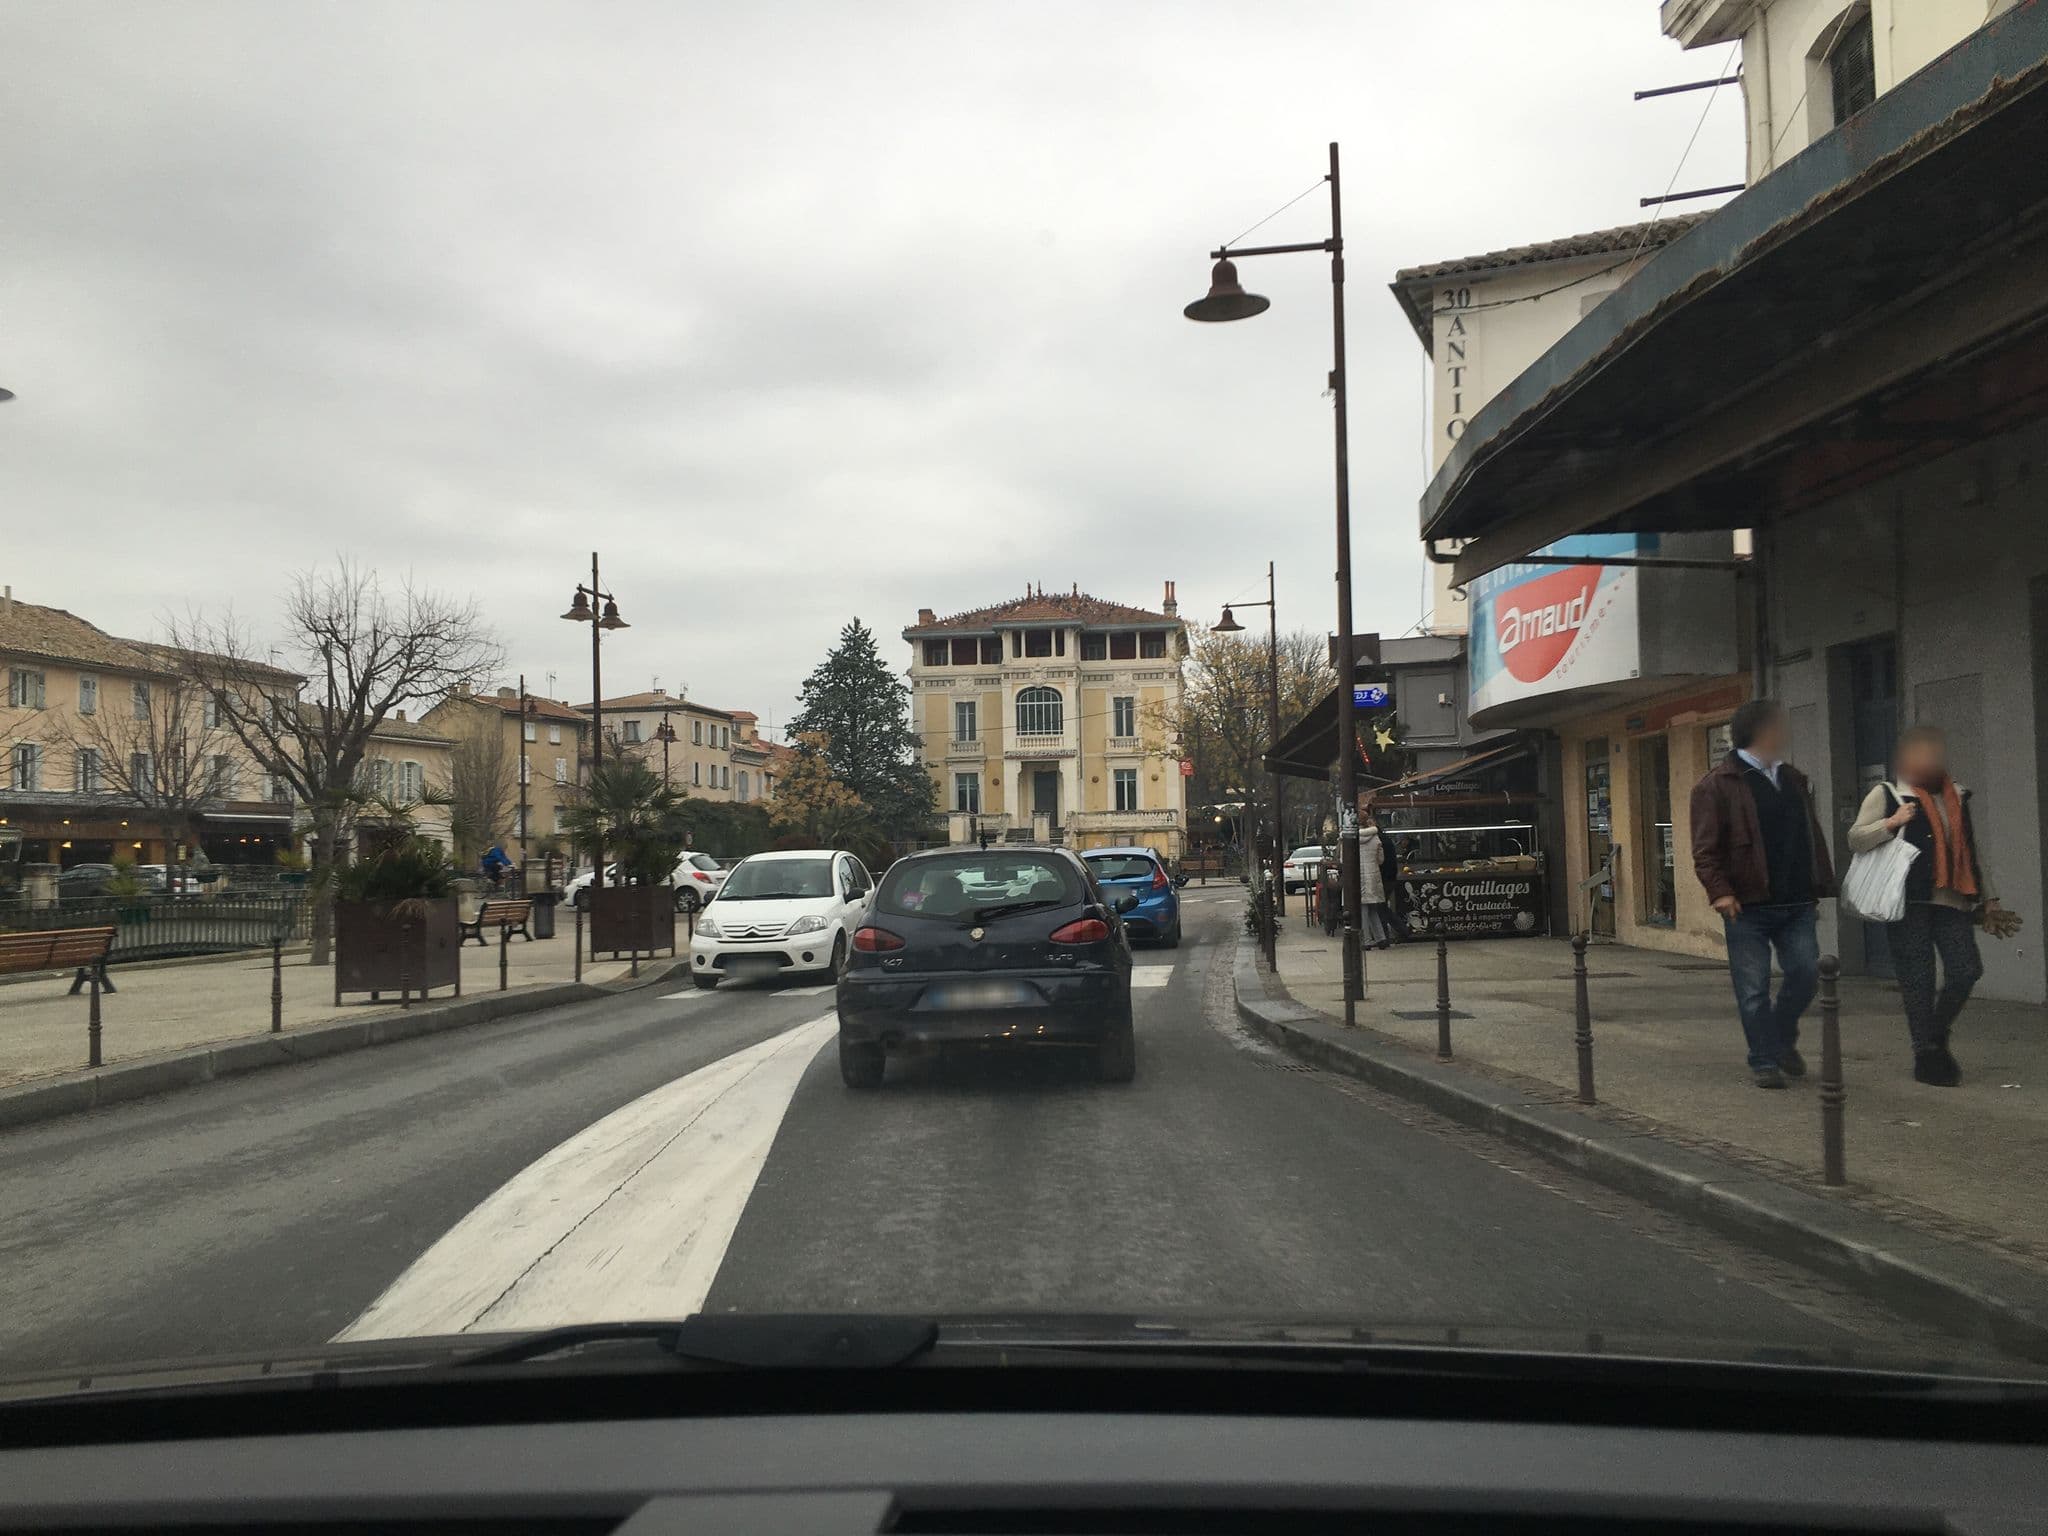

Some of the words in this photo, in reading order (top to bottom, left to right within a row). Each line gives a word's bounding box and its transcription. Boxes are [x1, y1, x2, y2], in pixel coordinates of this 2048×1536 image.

[1443, 287, 1471, 309] 30
[1443, 881, 1530, 900] Coquillages
[1455, 901, 1463, 911] &
